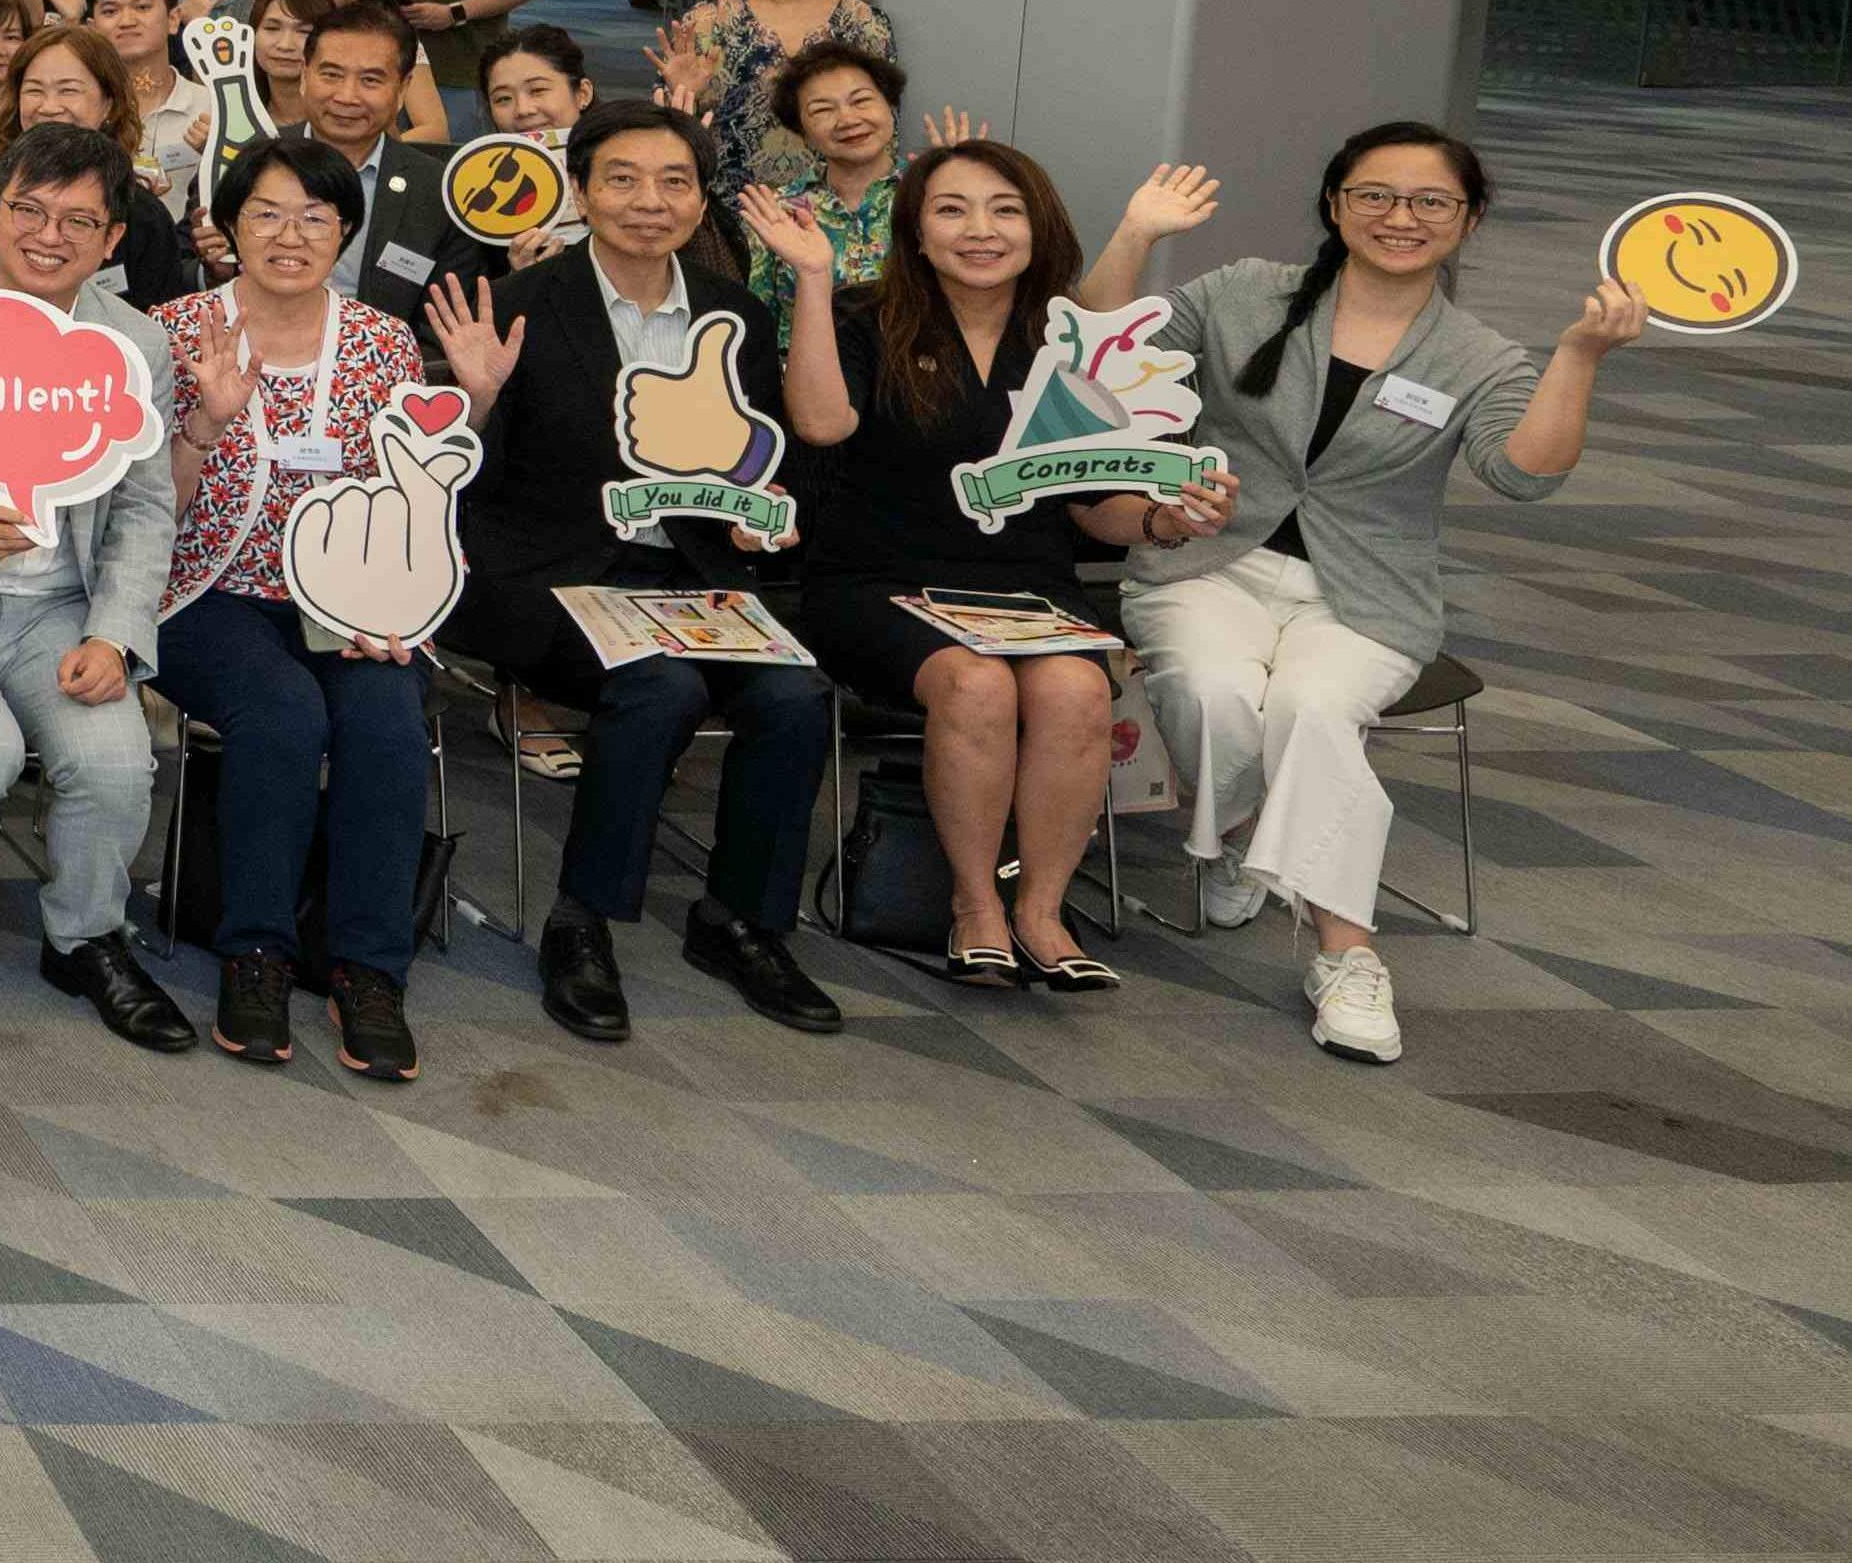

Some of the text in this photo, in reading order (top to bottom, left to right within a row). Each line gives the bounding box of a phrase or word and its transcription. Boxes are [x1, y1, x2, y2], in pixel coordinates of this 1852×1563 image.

[1017, 455, 1156, 480] Congrats
[644, 486, 753, 512] You did it
